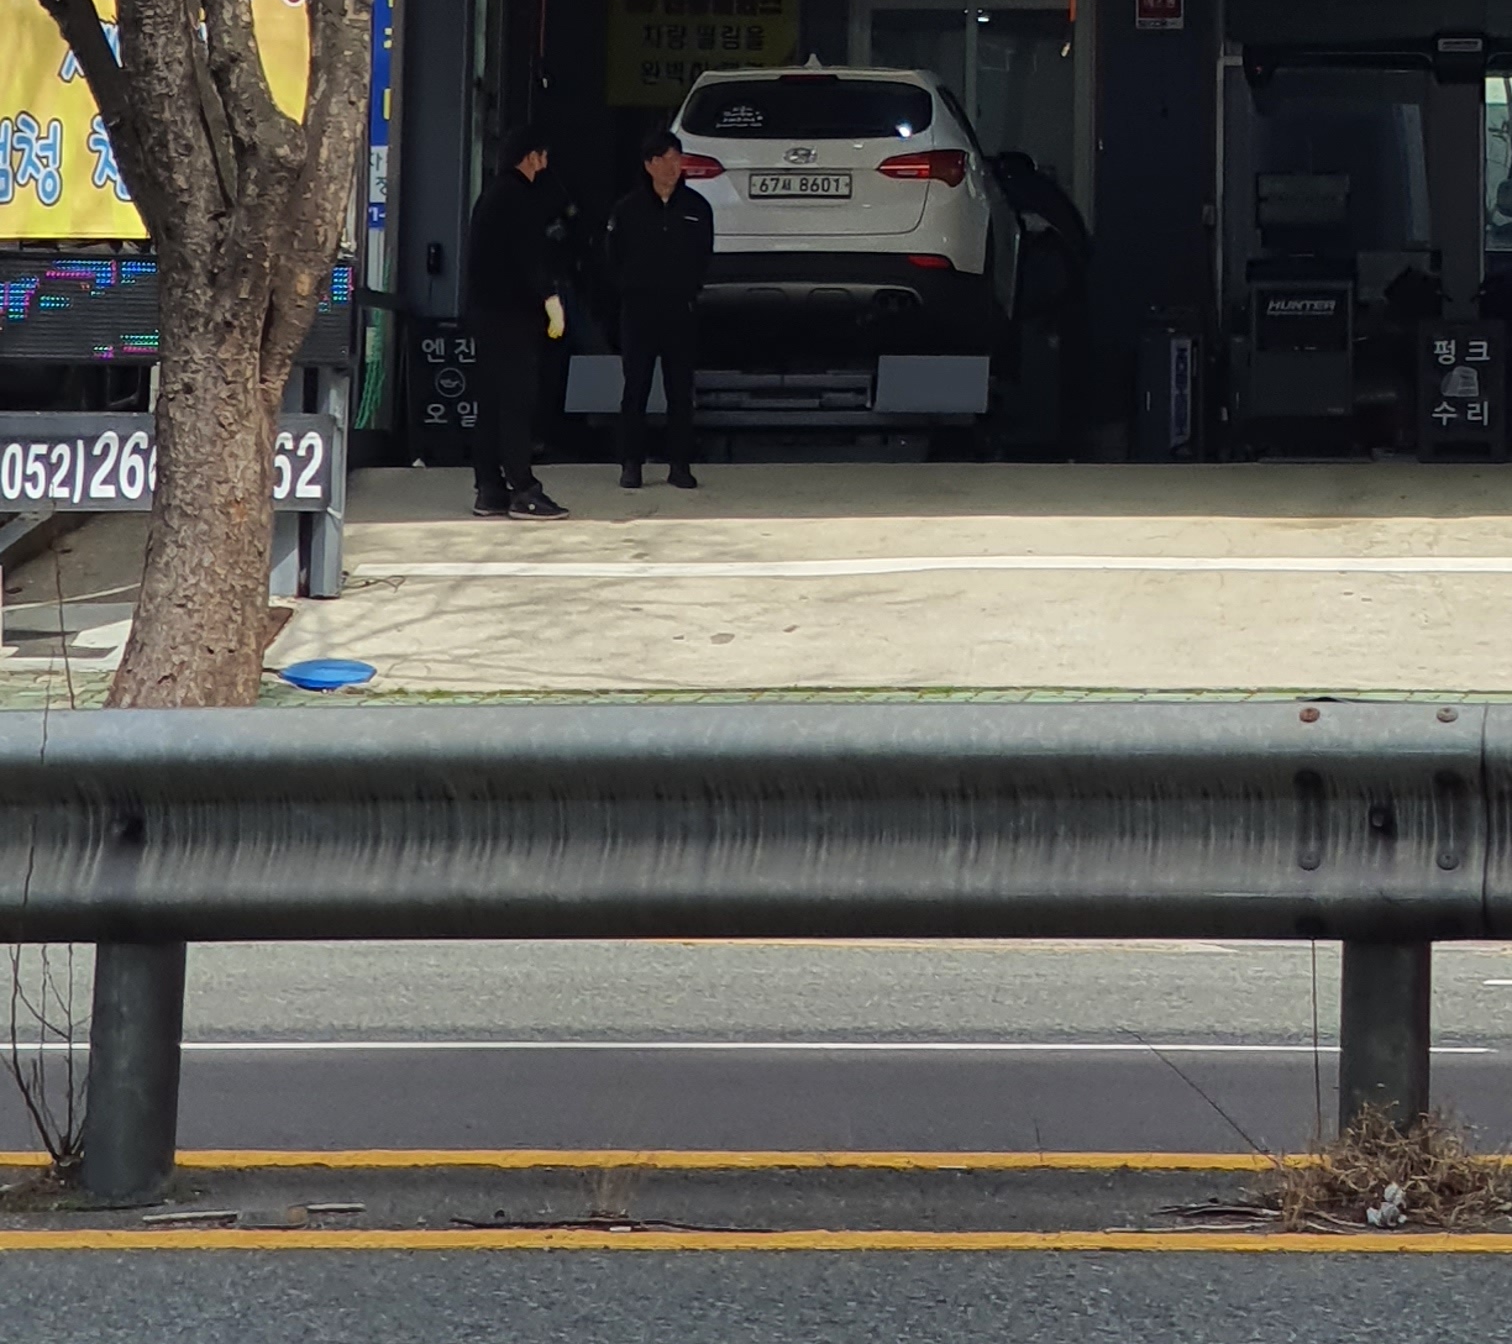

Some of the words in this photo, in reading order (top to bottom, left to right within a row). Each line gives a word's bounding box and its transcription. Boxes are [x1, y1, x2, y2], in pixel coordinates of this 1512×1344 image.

[800, 178, 840, 192] 8601
[421, 337, 477, 364] 엔진
[1432, 338, 1492, 366] 펑크
[423, 400, 479, 428] 오일
[1431, 399, 1490, 427] 수리
